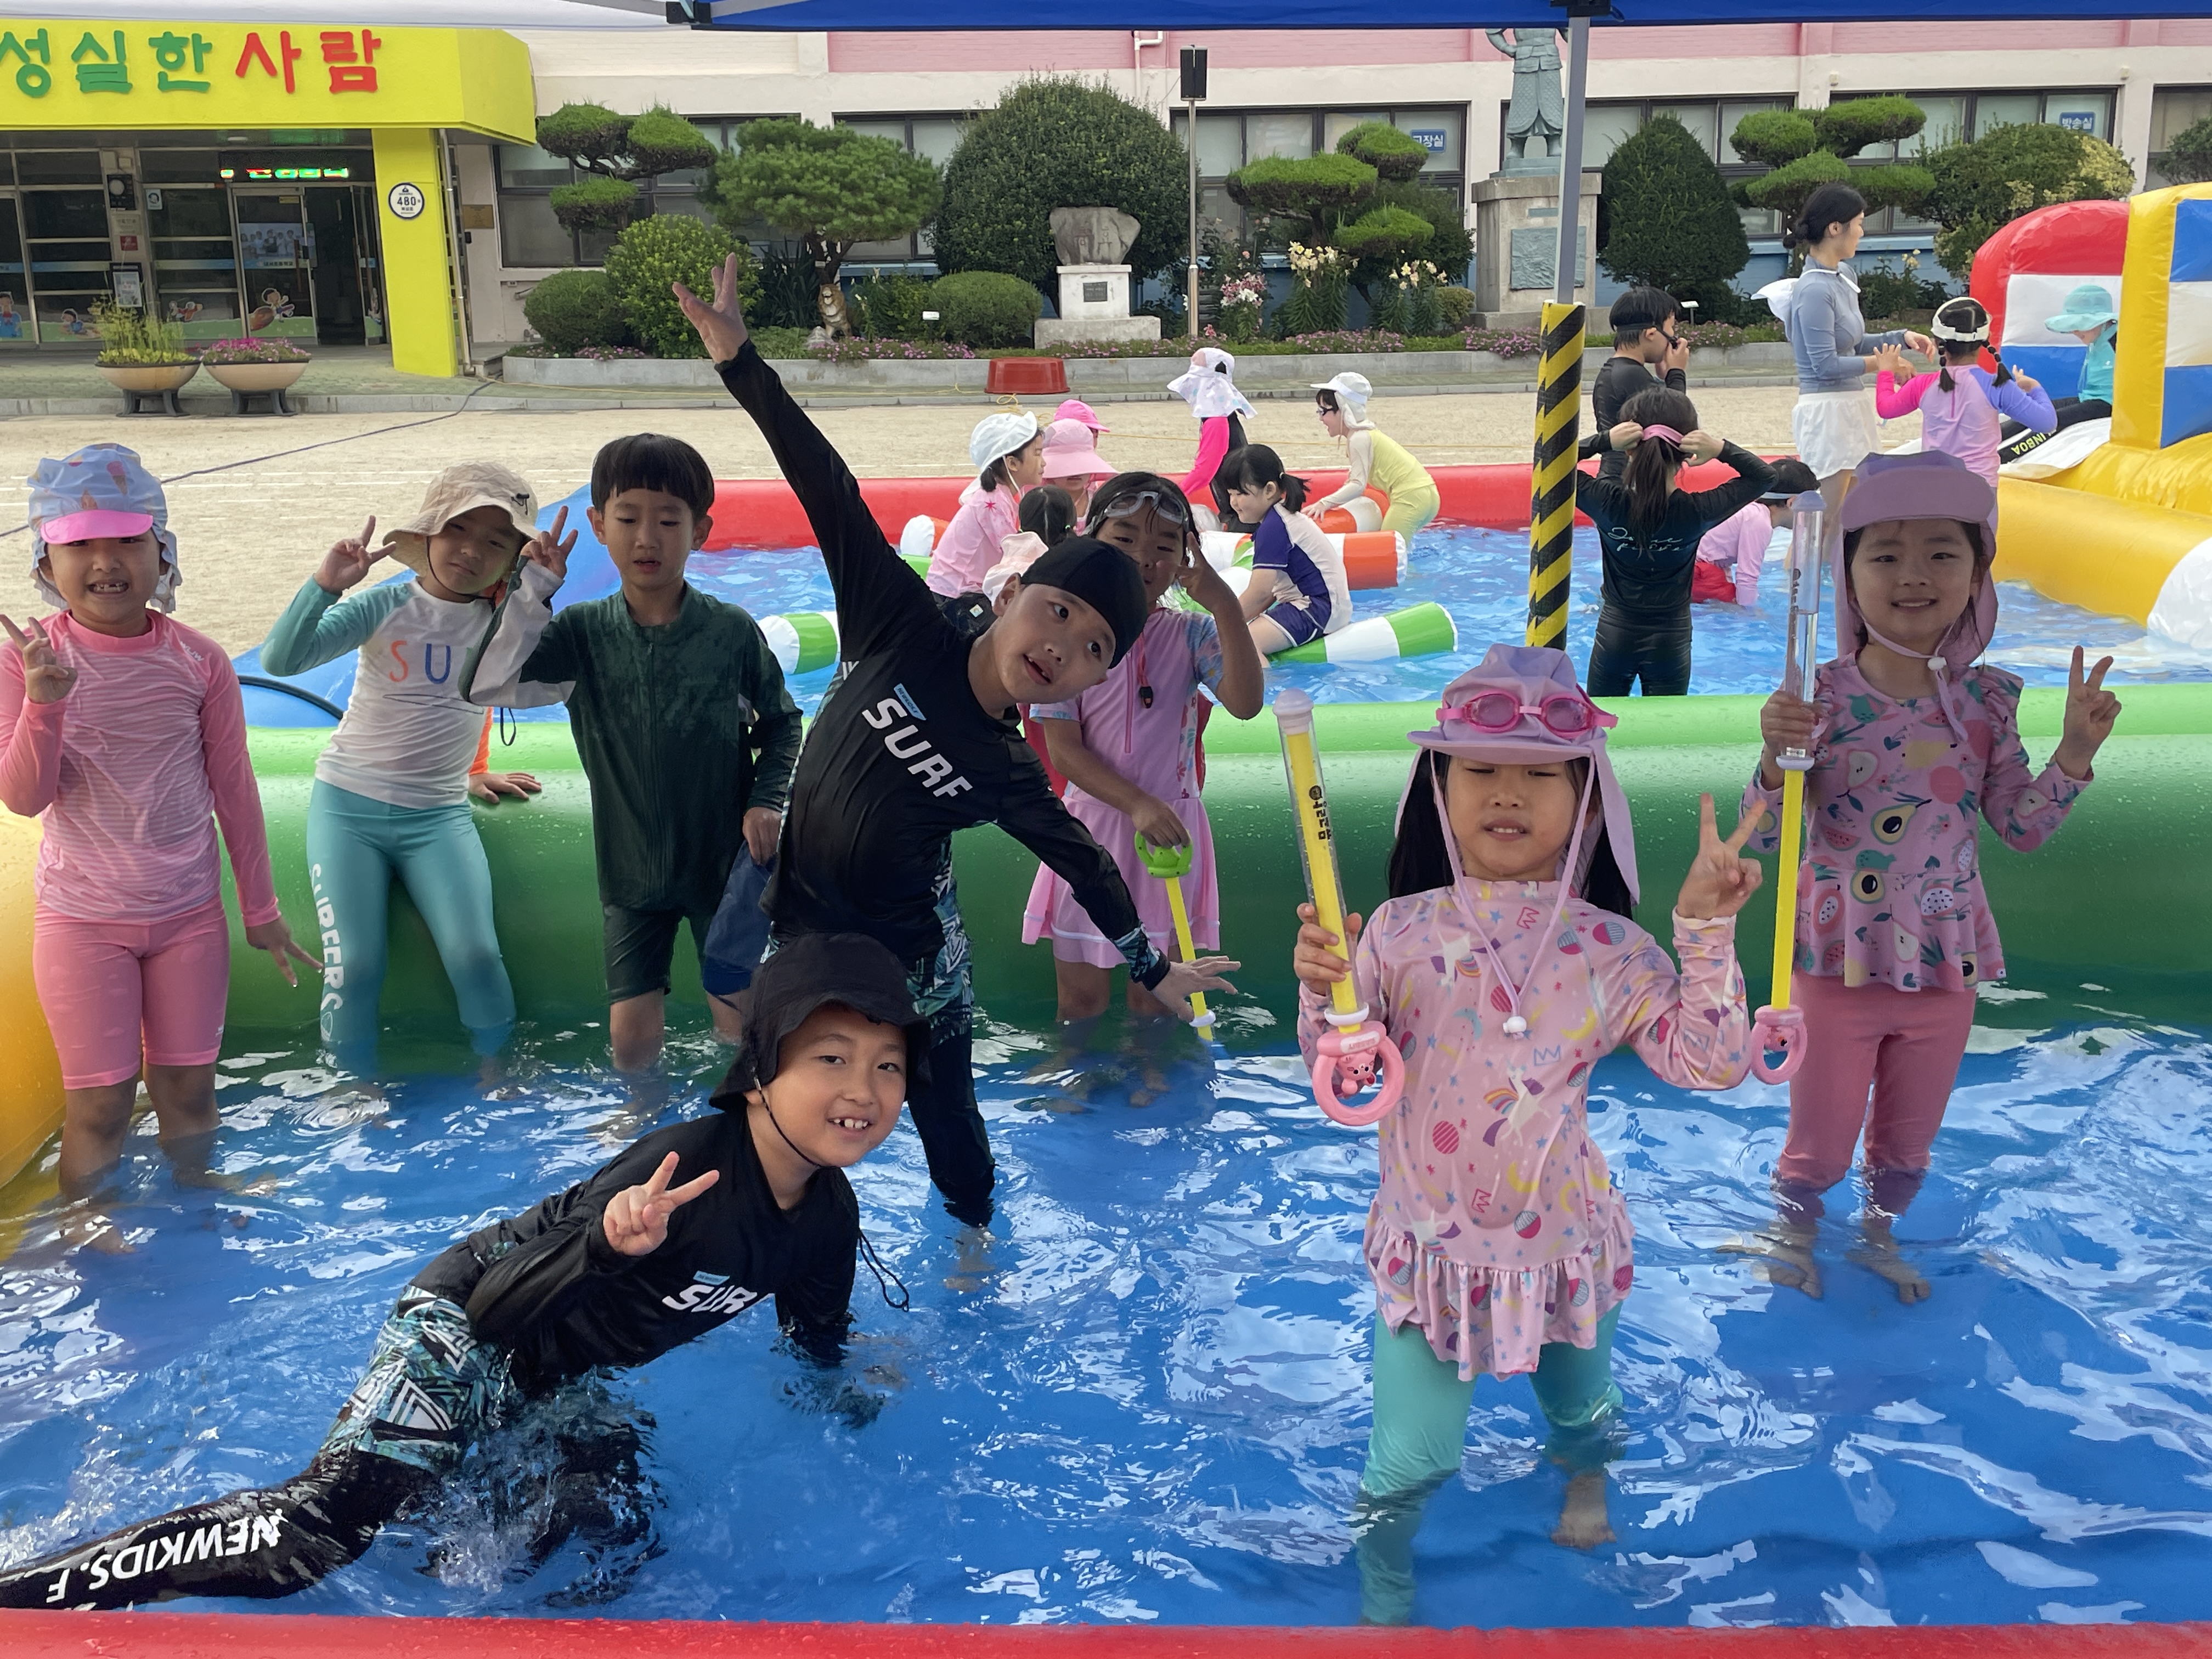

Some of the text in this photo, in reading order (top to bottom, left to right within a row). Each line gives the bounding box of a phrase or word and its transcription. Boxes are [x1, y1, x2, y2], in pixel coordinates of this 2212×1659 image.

[0, 28, 381, 98] 성실한 사람
[397, 196, 416, 206] 480
[862, 698, 973, 797] SURF
[662, 1284, 775, 1313] SUR
